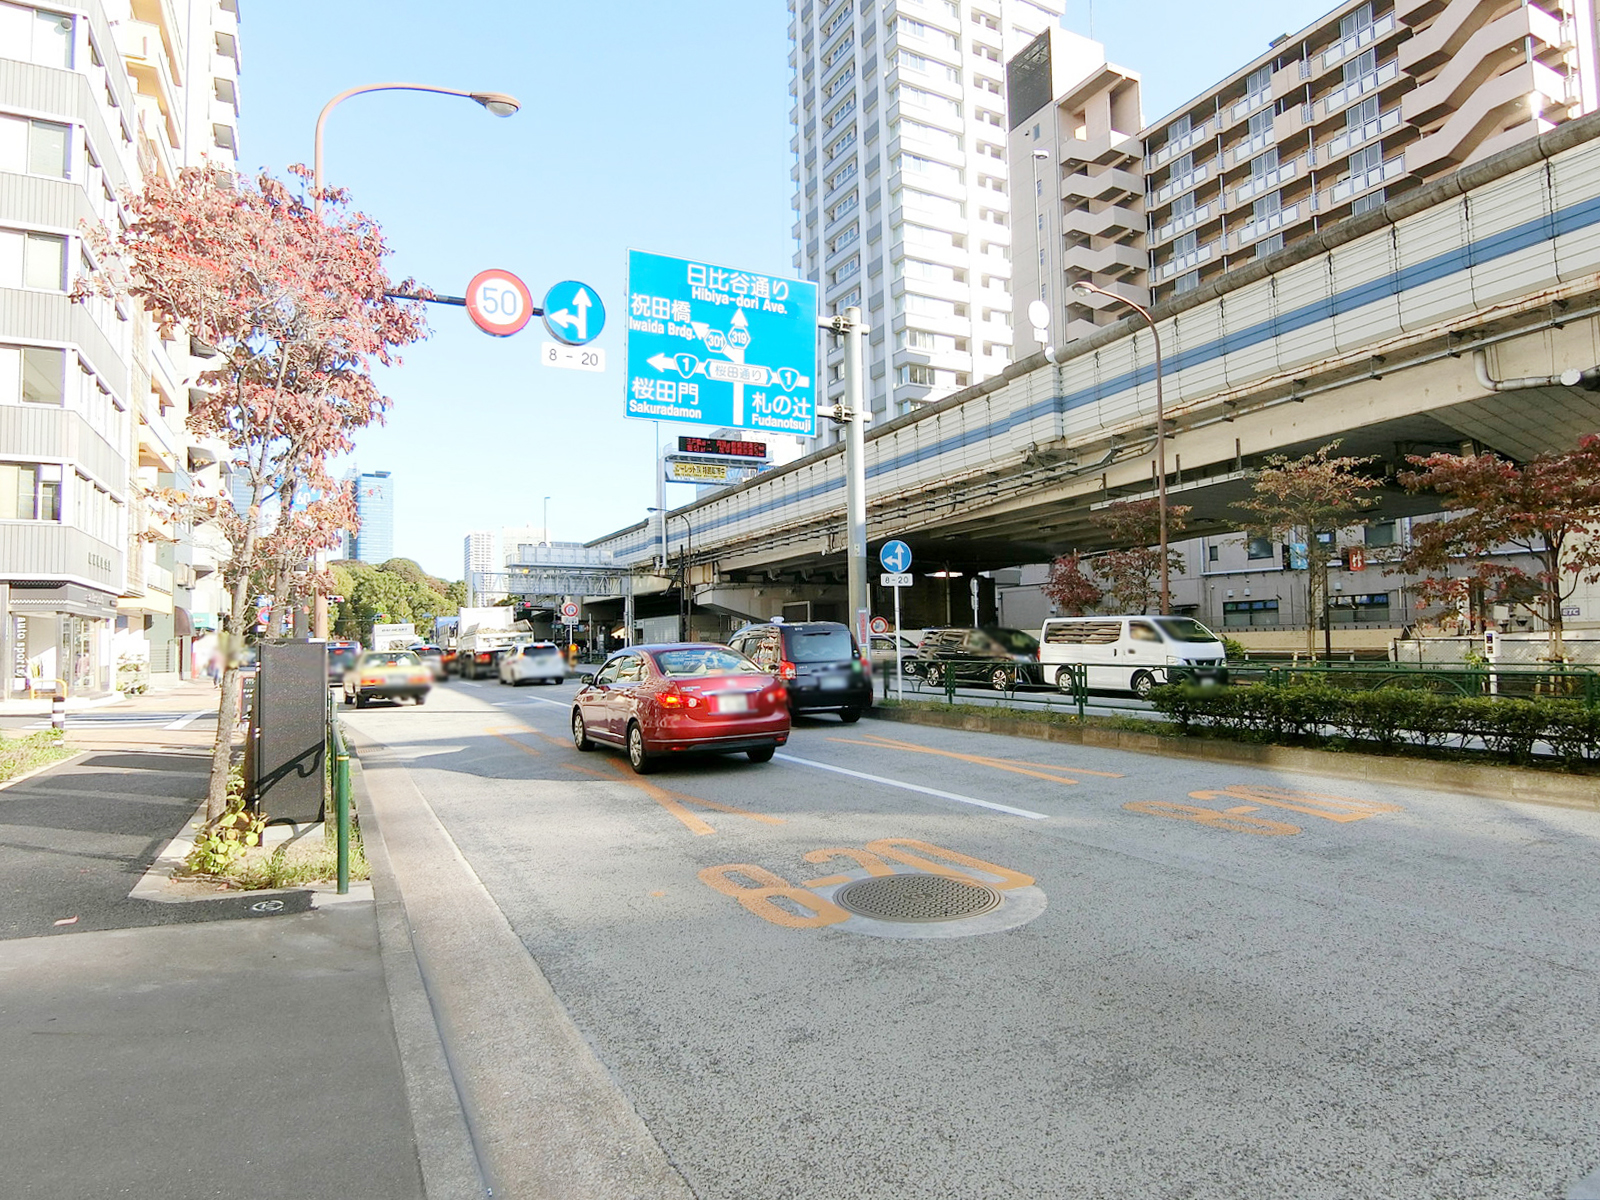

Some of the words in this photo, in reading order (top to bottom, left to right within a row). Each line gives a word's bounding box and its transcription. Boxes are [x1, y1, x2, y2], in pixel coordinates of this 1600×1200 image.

[687, 263, 789, 301] 日比谷通り
[482, 286, 517, 316] 50
[630, 292, 692, 324] 祝田橋
[691, 286, 759, 310] Hibiya-dori
[762, 298, 788, 315] Ave.
[628, 315, 665, 334] Iwaida
[667, 321, 696, 341] Brdg.
[731, 330, 747, 345] 319
[708, 334, 724, 348] 301
[682, 357, 690, 372] 1
[714, 364, 762, 381] 桜田通り
[784, 371, 792, 386] 1
[631, 376, 699, 406] 桜田門
[628, 398, 702, 419] Sakuradamon
[751, 391, 812, 419] 札の辻
[751, 412, 812, 433] Fudanotsuji
[16, 617, 28, 639] auto
